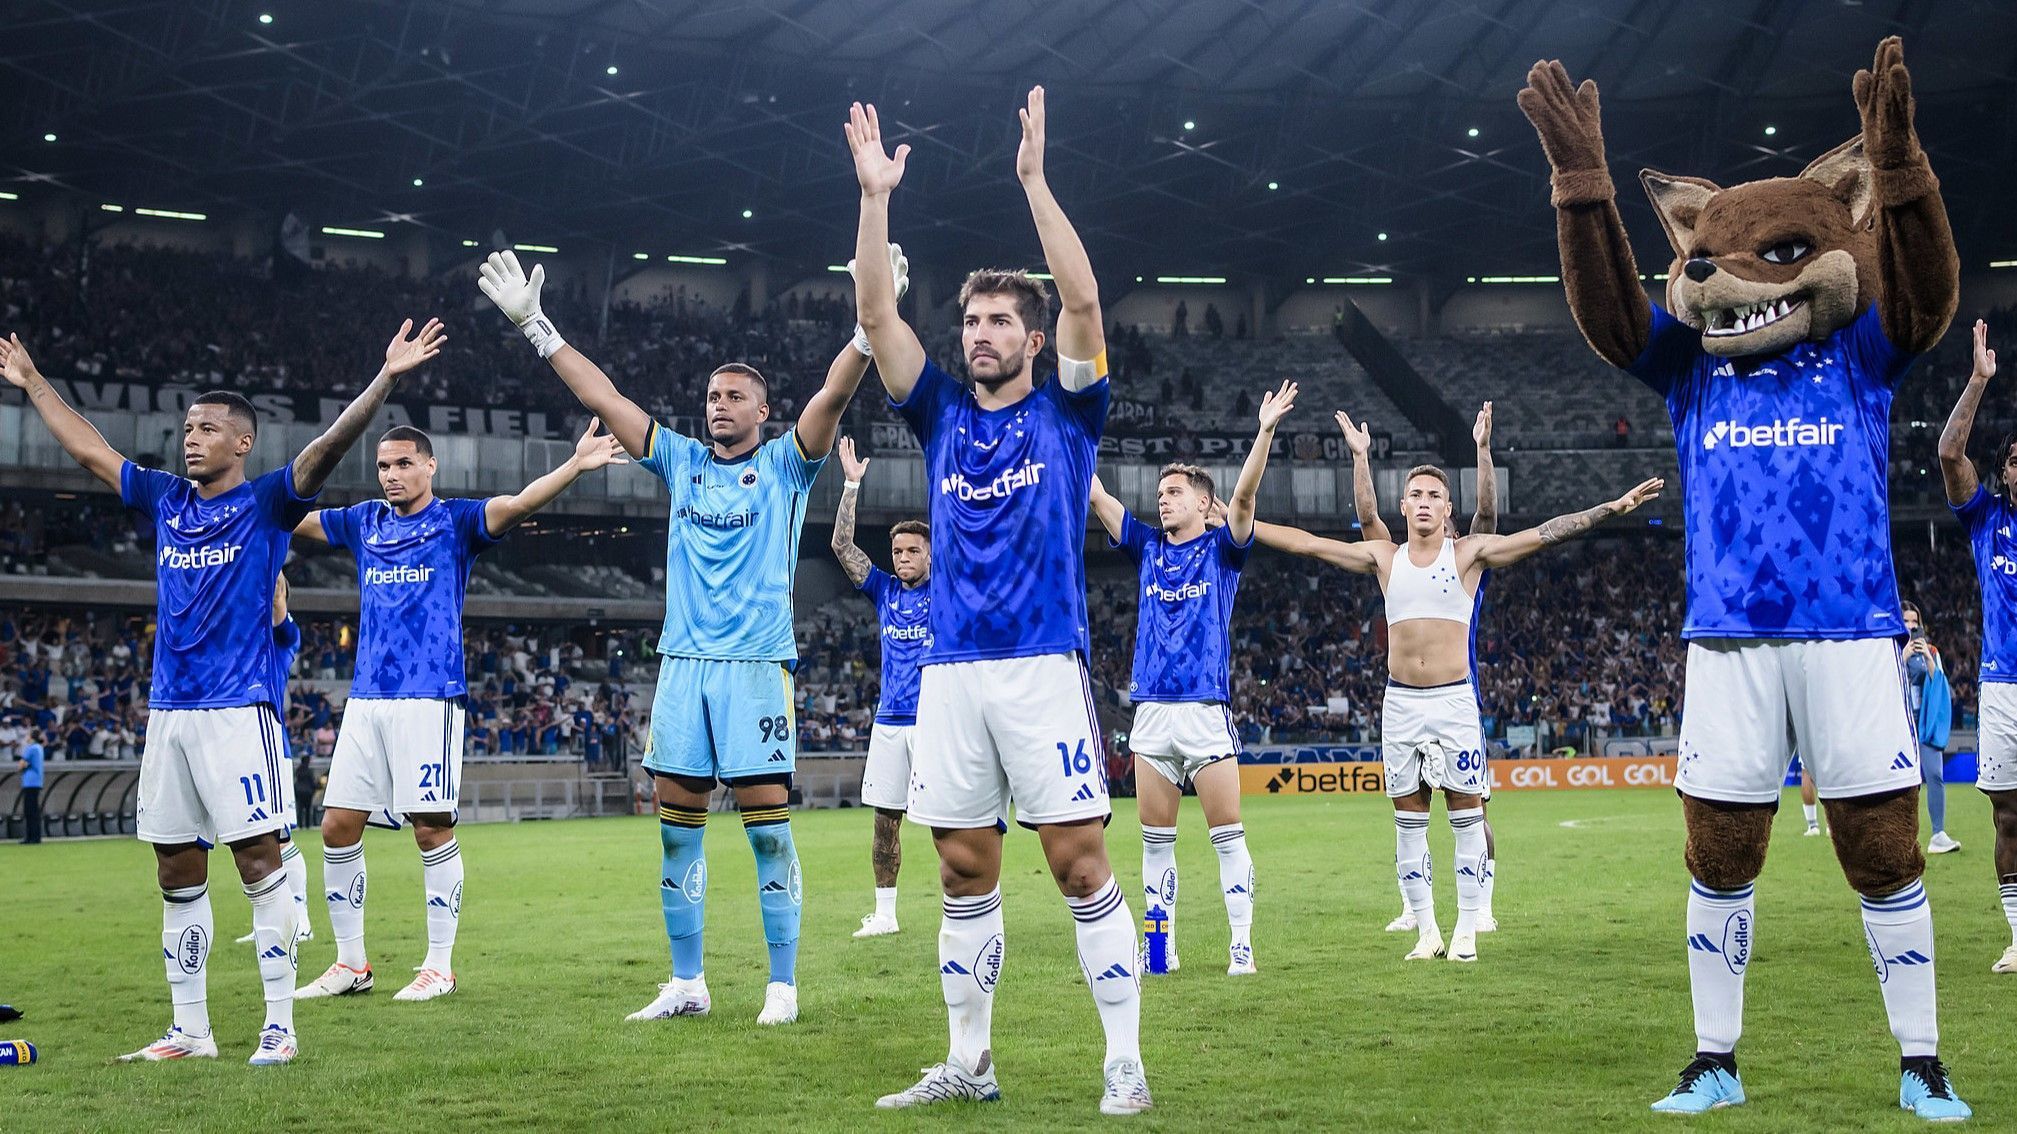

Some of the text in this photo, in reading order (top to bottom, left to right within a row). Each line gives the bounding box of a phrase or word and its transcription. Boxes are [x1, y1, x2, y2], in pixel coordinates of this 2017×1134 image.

[429, 405, 560, 438] FIEL
[1729, 417, 1844, 448] betfair
[957, 458, 1045, 501] betfair
[690, 505, 759, 529] betfair
[169, 542, 242, 570] betfair
[372, 564, 435, 585] betfair
[892, 625, 928, 640] betfa
[758, 715, 790, 743] 98
[1056, 738, 1091, 778] 16
[1456, 749, 1481, 771] 80
[239, 773, 266, 805] 11
[418, 763, 442, 788] 27
[1298, 766, 1386, 793] betfa
[1510, 765, 1557, 788] GOL
[1566, 765, 1615, 787] GOL
[1624, 763, 1671, 785] GOL
[354, 874, 366, 905] Kodilar
[690, 863, 704, 898] Kodilar
[1165, 870, 1176, 902] Kodilar
[184, 929, 200, 969] Kodilar
[1734, 915, 1748, 966] Kodilar
[984, 938, 1003, 986] Kodilar
